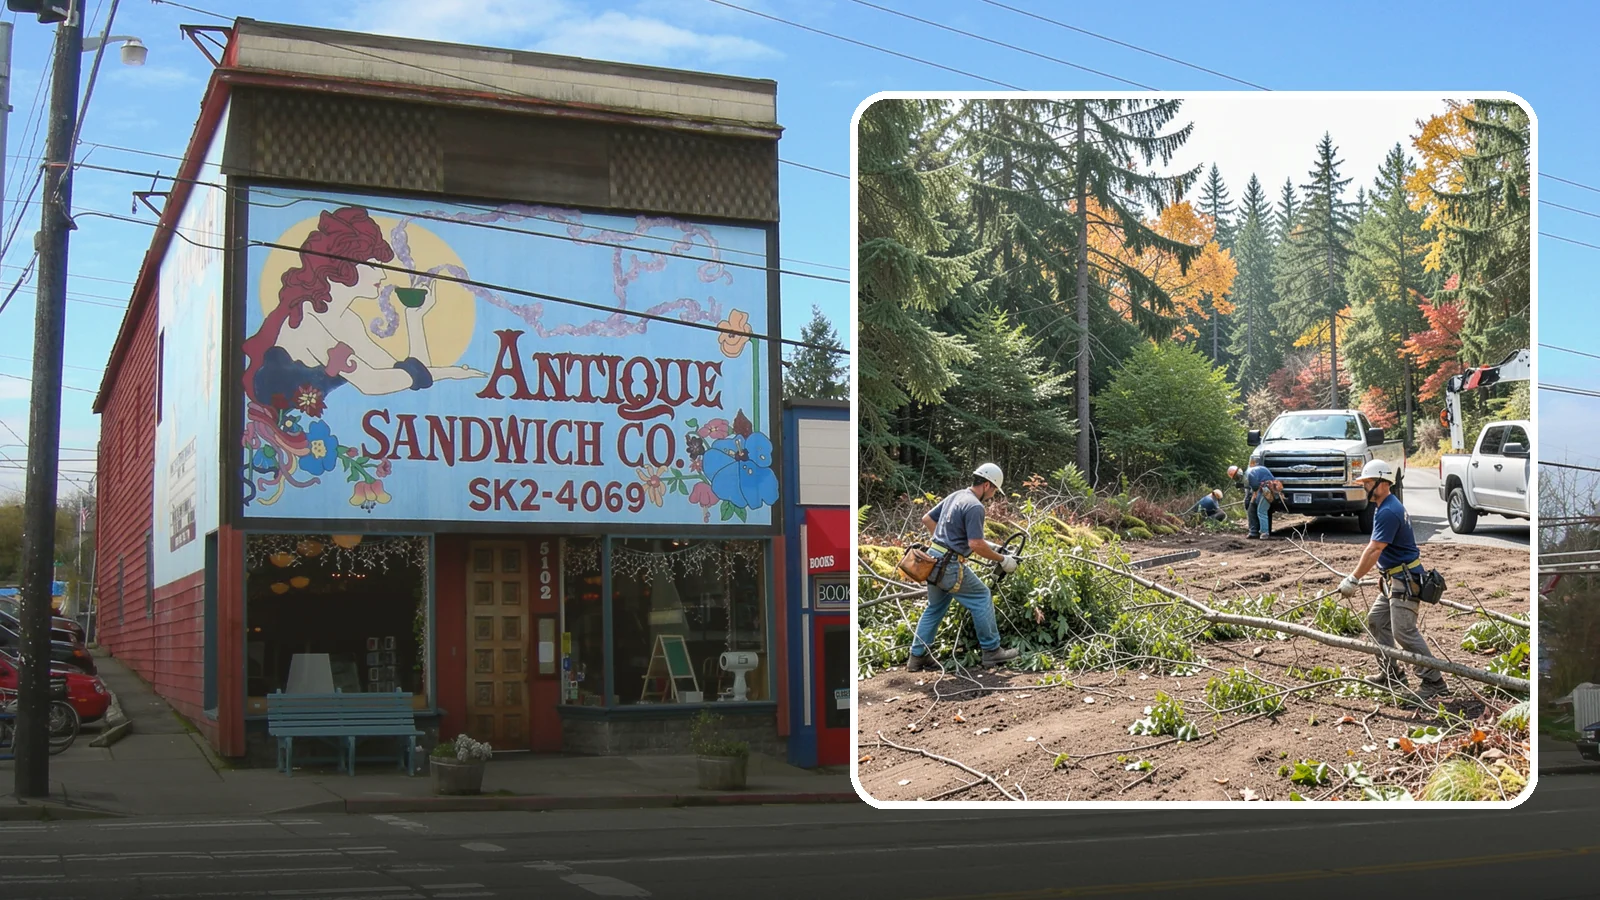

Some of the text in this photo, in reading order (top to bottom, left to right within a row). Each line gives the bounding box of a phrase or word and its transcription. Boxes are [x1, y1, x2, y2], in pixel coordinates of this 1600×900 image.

[475, 329, 723, 420] ANTIQUE
[361, 409, 685, 469] SANDWICH CO.
[468, 477, 647, 513] SK2-4069
[540, 541, 552, 600] 5102
[809, 555, 835, 569] BOOKS
